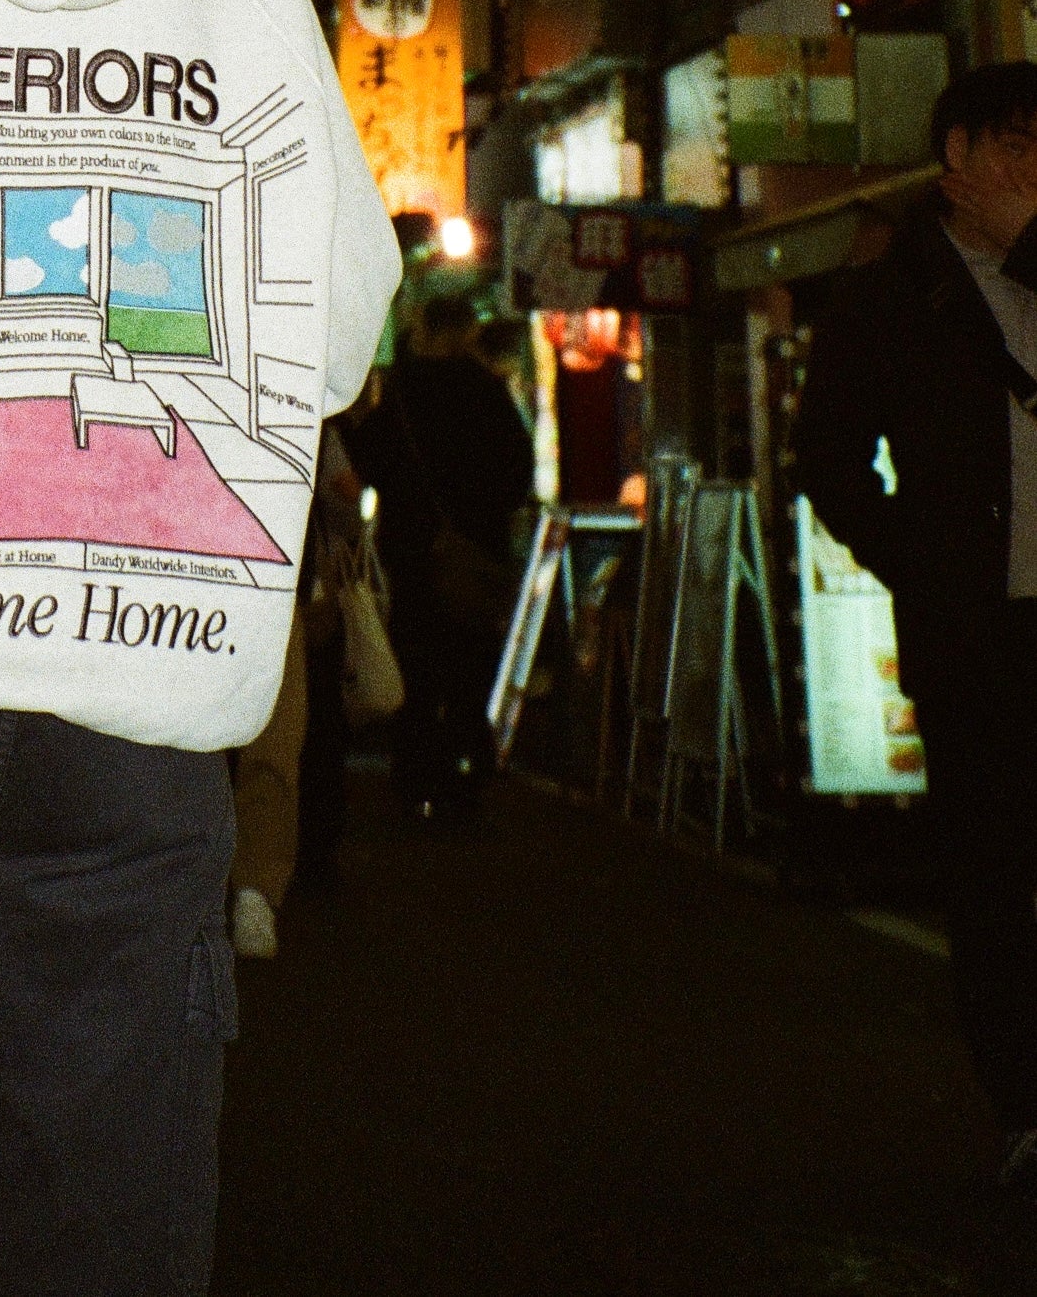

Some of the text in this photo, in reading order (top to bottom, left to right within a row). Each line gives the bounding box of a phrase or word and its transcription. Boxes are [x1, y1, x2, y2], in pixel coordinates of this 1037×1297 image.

[18, 125, 48, 142] bring
[50, 128, 77, 141] your
[80, 128, 107, 139] own
[109, 127, 143, 142] colors
[145, 131, 155, 143] to
[156, 131, 171, 146] the
[46, 154, 56, 167] is
[59, 153, 77, 167] the
[80, 154, 126, 169] product
[128, 157, 139, 170] of
[139, 160, 161, 174] you.
[51, 328, 91, 343] Home.
[259, 383, 314, 414] Keep Warm
[4, 551, 14, 563] at
[18, 550, 56, 563] Home
[92, 551, 237, 580] Dandy Worldwide Interiors.
[71, 581, 237, 655] Home.
